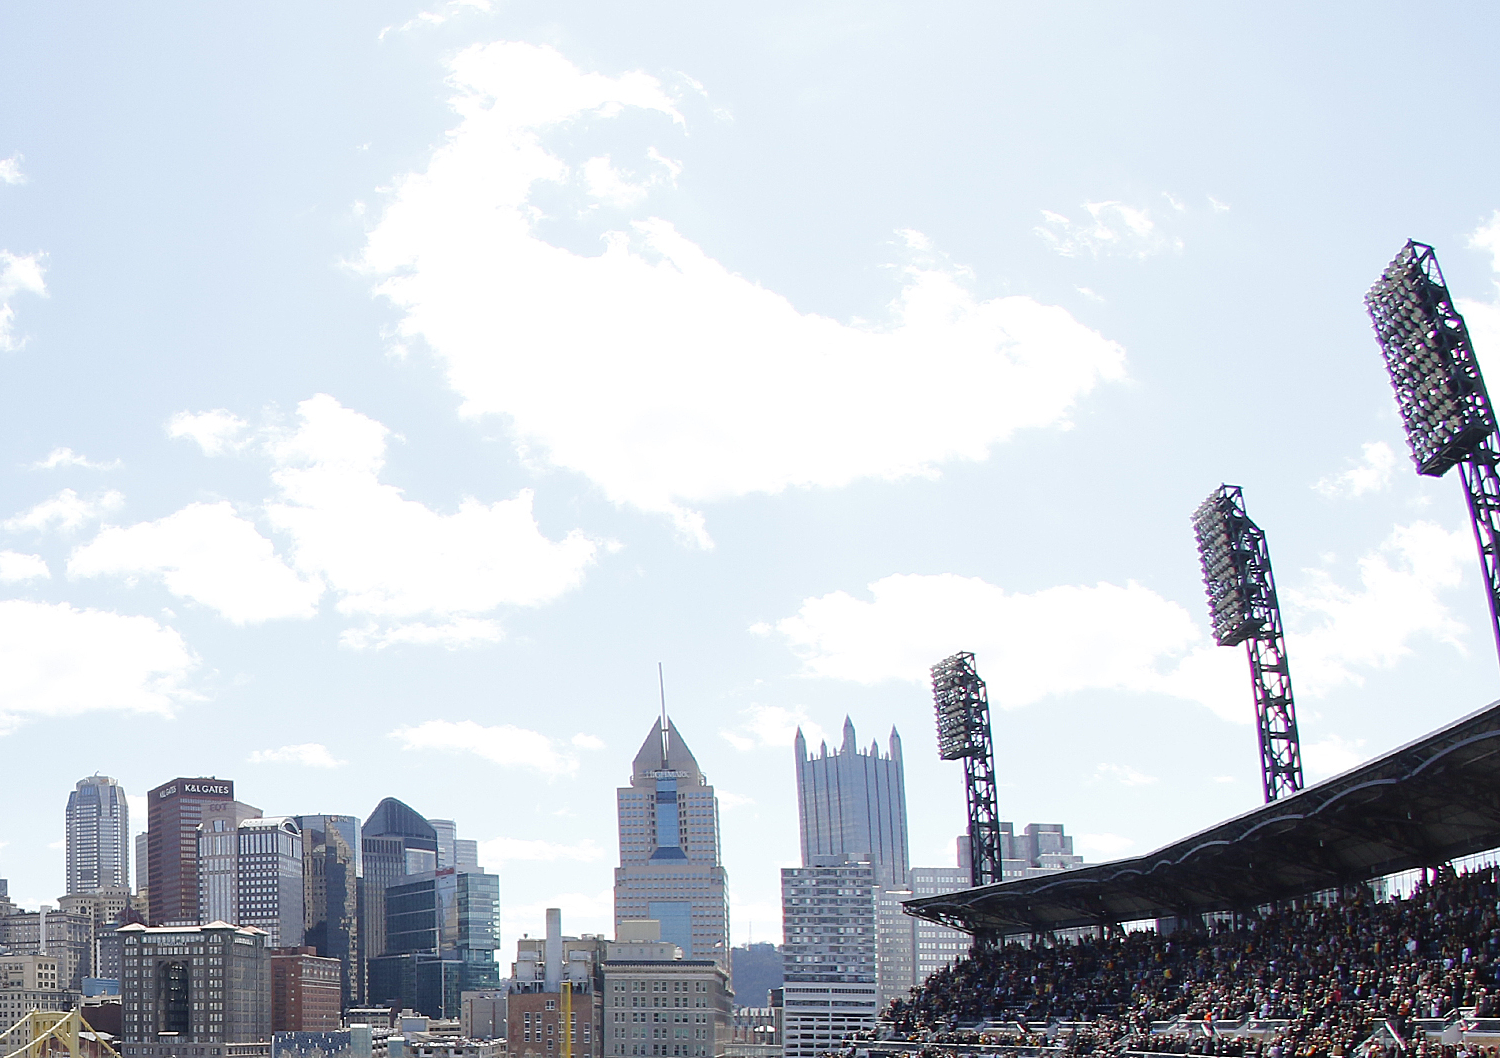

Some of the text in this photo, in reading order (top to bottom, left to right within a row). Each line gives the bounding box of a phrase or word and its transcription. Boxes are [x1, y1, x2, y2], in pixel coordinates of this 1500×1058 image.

[185, 784, 229, 794] K&L GATES
[209, 803, 227, 812] EQT
